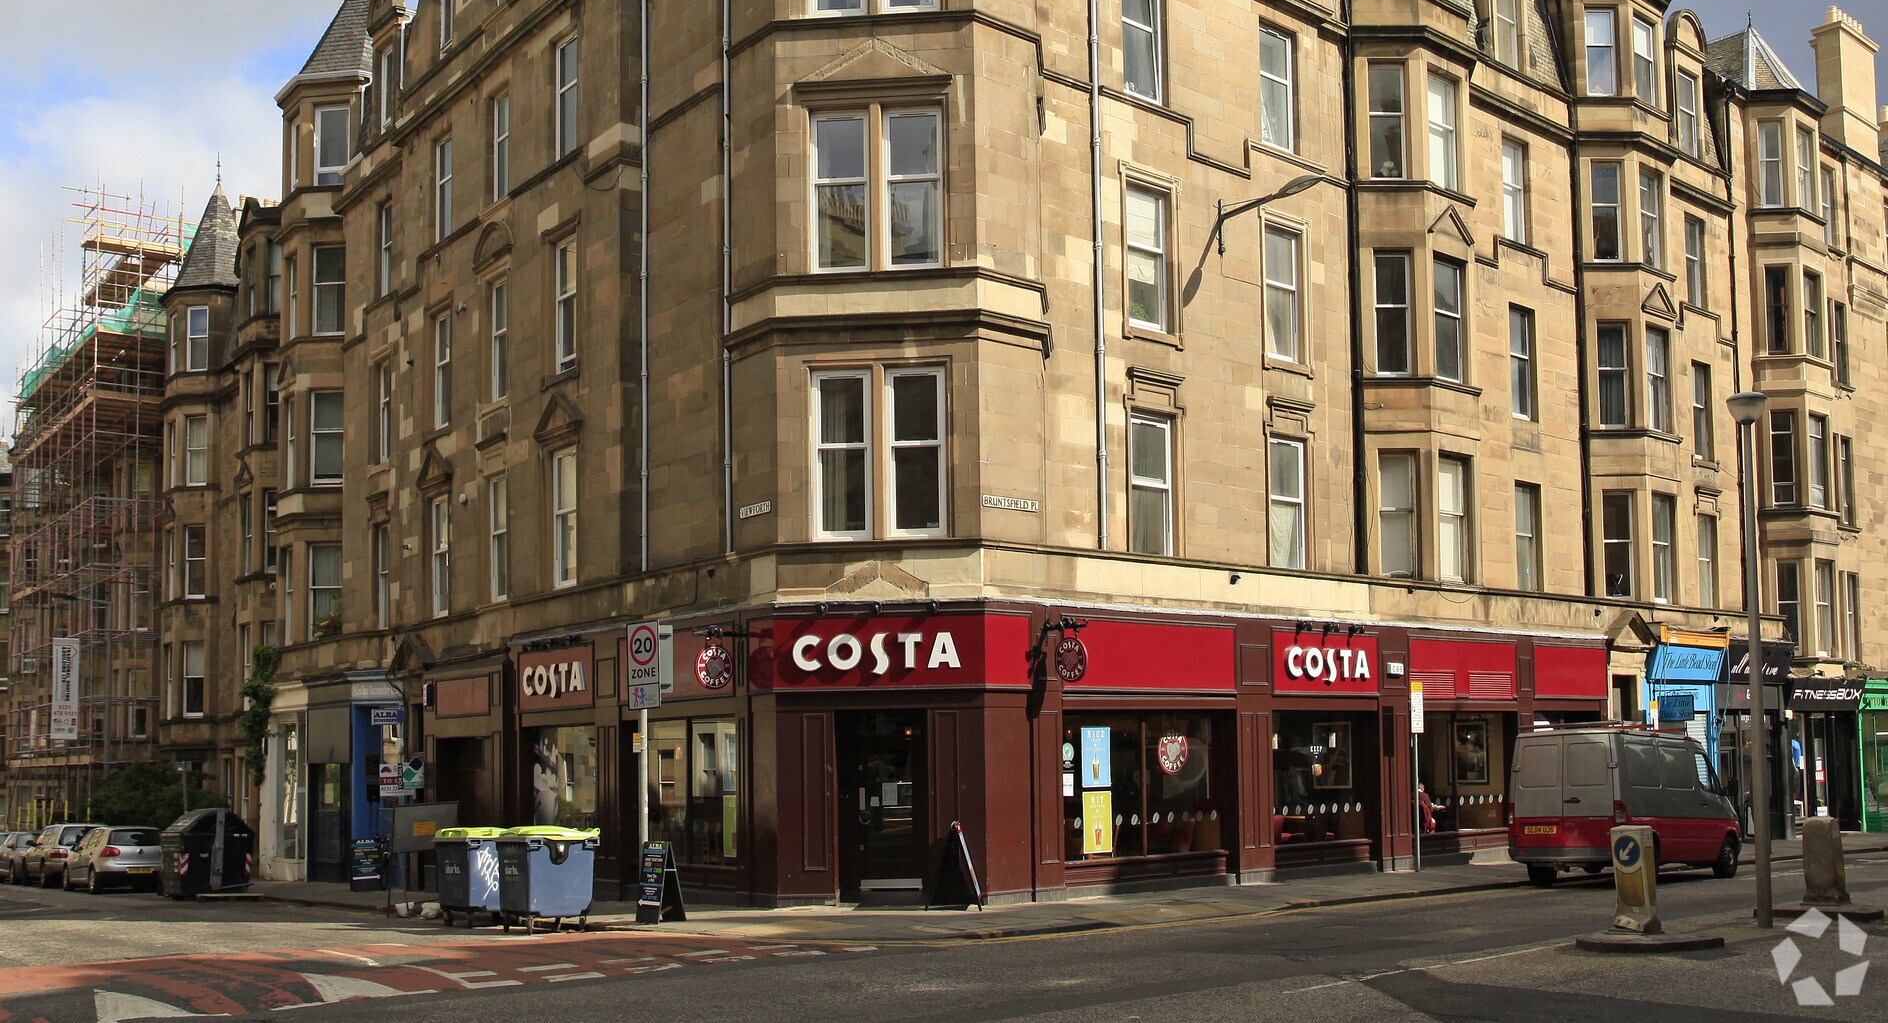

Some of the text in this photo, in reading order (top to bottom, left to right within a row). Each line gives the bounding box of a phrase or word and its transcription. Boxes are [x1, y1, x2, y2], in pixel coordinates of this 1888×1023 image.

[740, 501, 770, 517] VIEWFORTH
[984, 496, 1038, 511] BRUNTSFIELD PL
[634, 637, 652, 654] 20
[1059, 641, 1080, 654] COSTA
[702, 648, 726, 660] COSTA
[792, 632, 962, 675] COSTA
[1287, 646, 1370, 682] COSTA
[1665, 652, 1674, 668] The
[1688, 653, 1706, 669] Bead
[1703, 654, 1717, 673] Shop
[632, 667, 656, 679] ZONE
[701, 671, 729, 686] COFFEE
[1058, 664, 1082, 678] COFFEE
[523, 661, 586, 698] COSTA
[1661, 698, 1671, 707] The
[1087, 730, 1105, 738] NICE
[1163, 731, 1183, 743] COSTA
[1161, 755, 1185, 770] COFFEE
